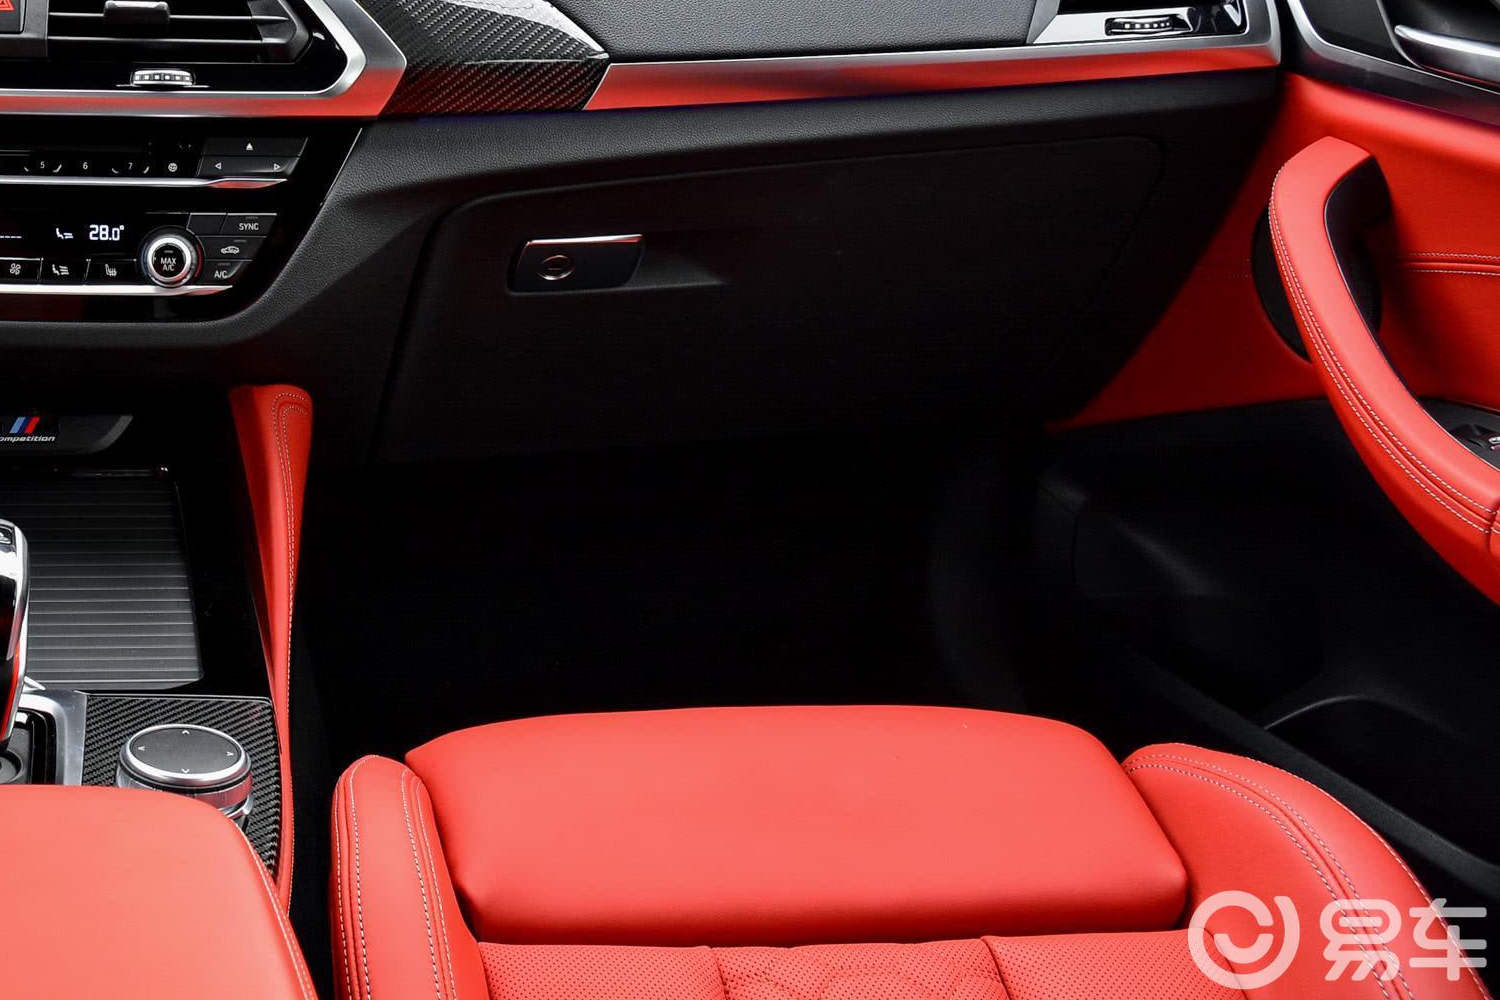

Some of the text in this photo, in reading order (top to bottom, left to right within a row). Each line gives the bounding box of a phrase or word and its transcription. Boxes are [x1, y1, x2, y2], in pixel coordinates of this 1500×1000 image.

[40, 161, 45, 169] 5
[82, 161, 88, 170] 6
[128, 162, 133, 170] 7
[238, 222, 259, 231] SYNC
[160, 257, 176, 265] MAX
[162, 264, 175, 272] A/C
[214, 269, 228, 279] A/C
